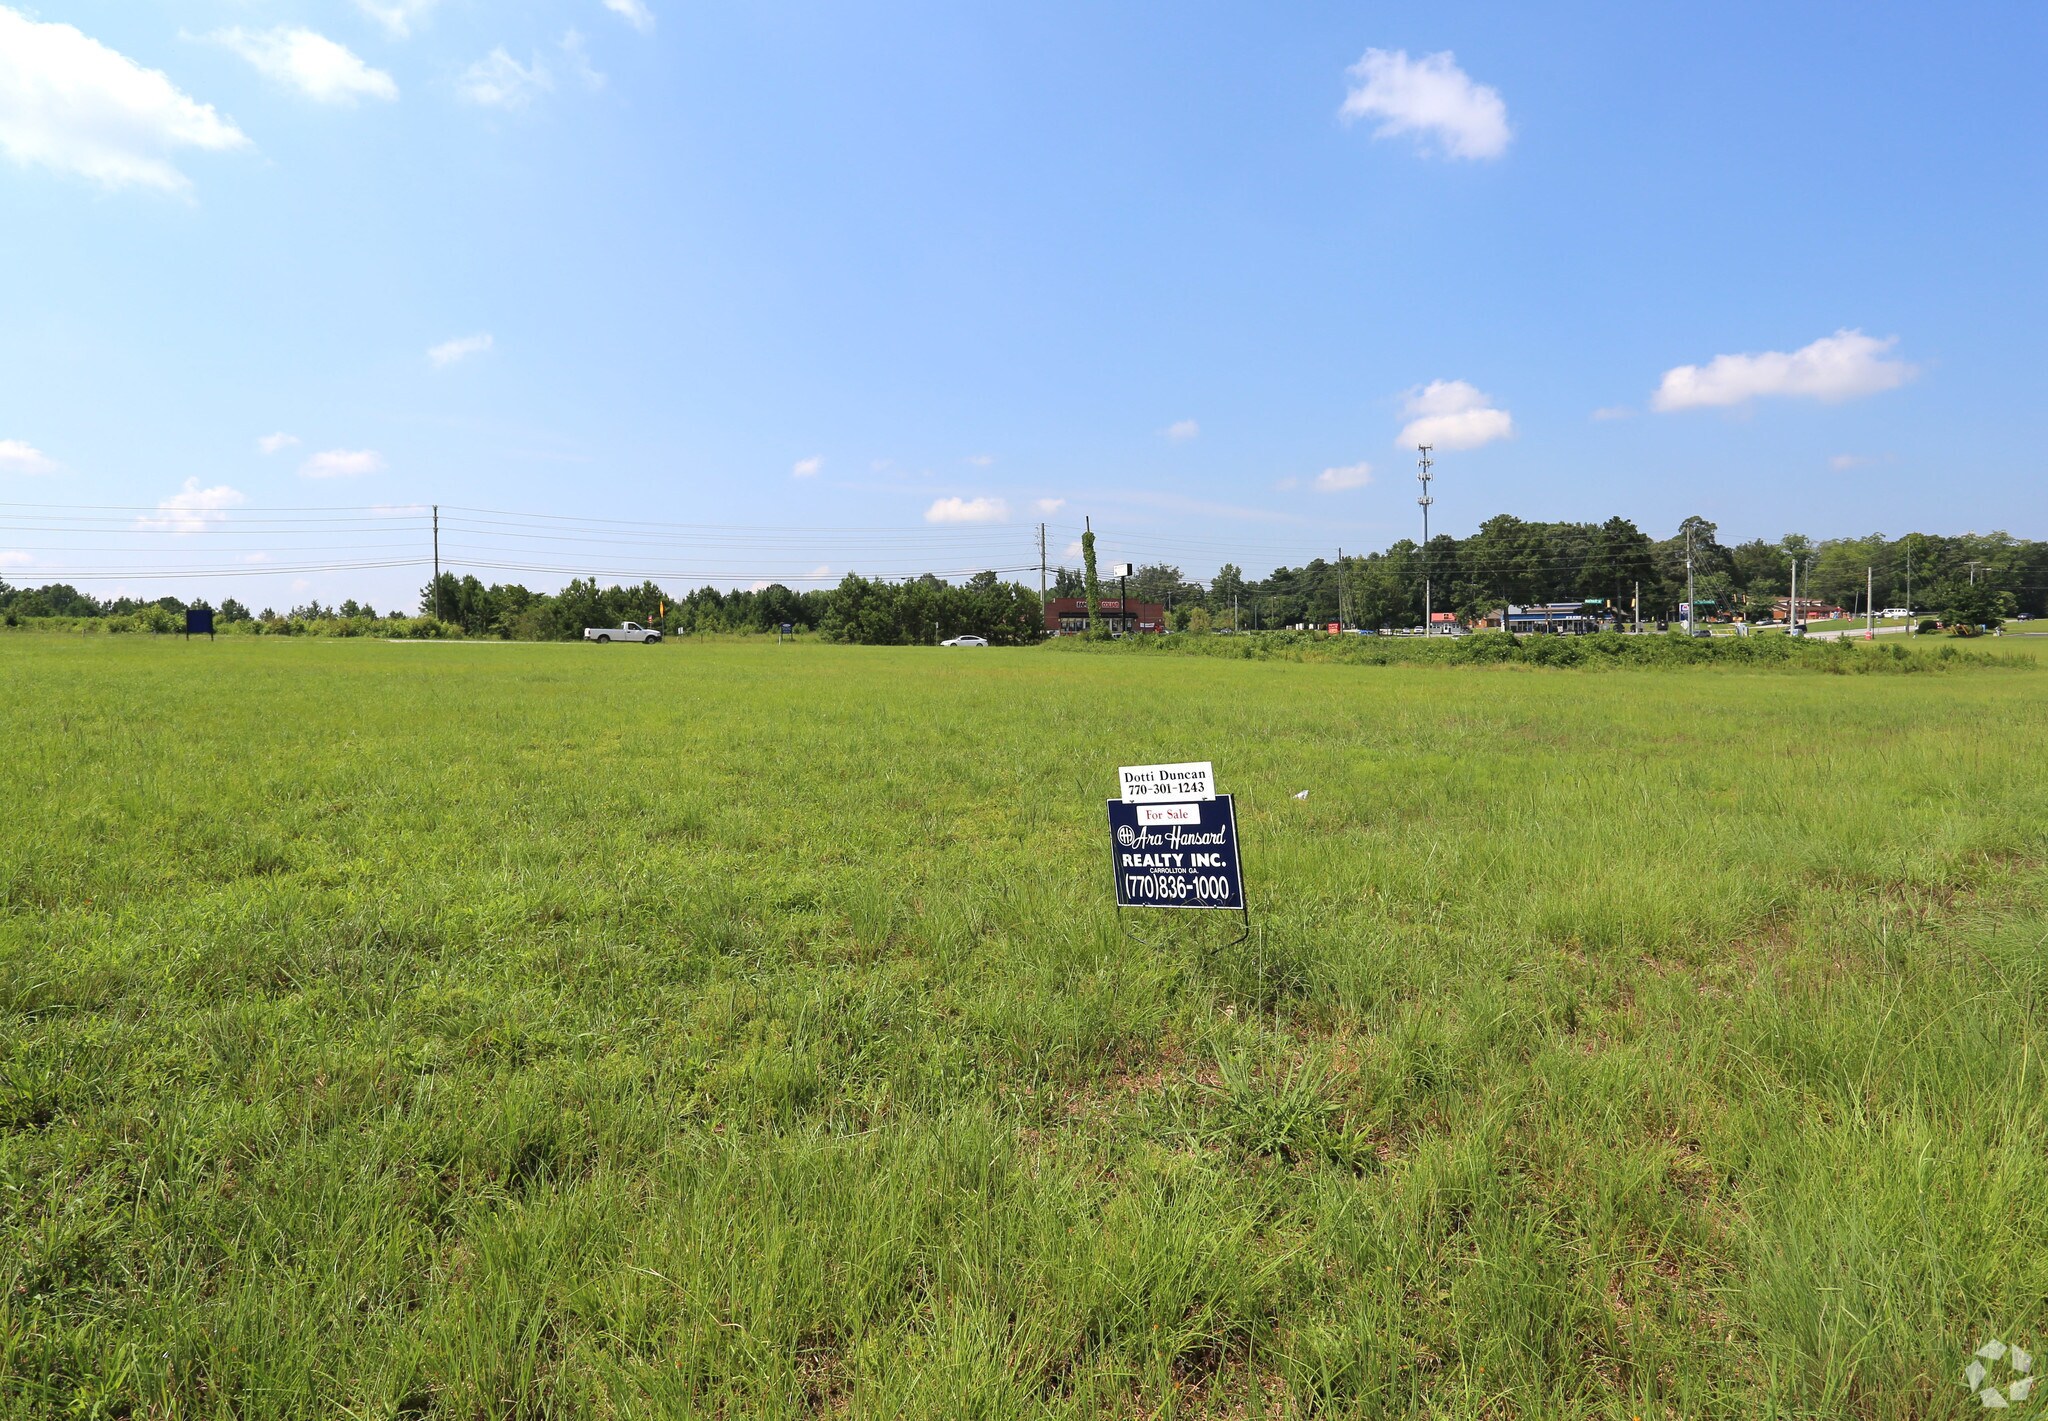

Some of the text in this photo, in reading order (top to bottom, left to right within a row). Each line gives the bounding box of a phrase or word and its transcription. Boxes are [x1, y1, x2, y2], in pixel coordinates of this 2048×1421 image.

[1124, 770, 1206, 783] Dotti Duncan
[1128, 781, 1205, 795] 770-301-1243
[1146, 809, 1189, 820] For Sale
[1132, 824, 1226, 850] Ara Hansard
[1122, 853, 1227, 867] REALTY INC.
[1126, 873, 1229, 900] (770)836-1000
